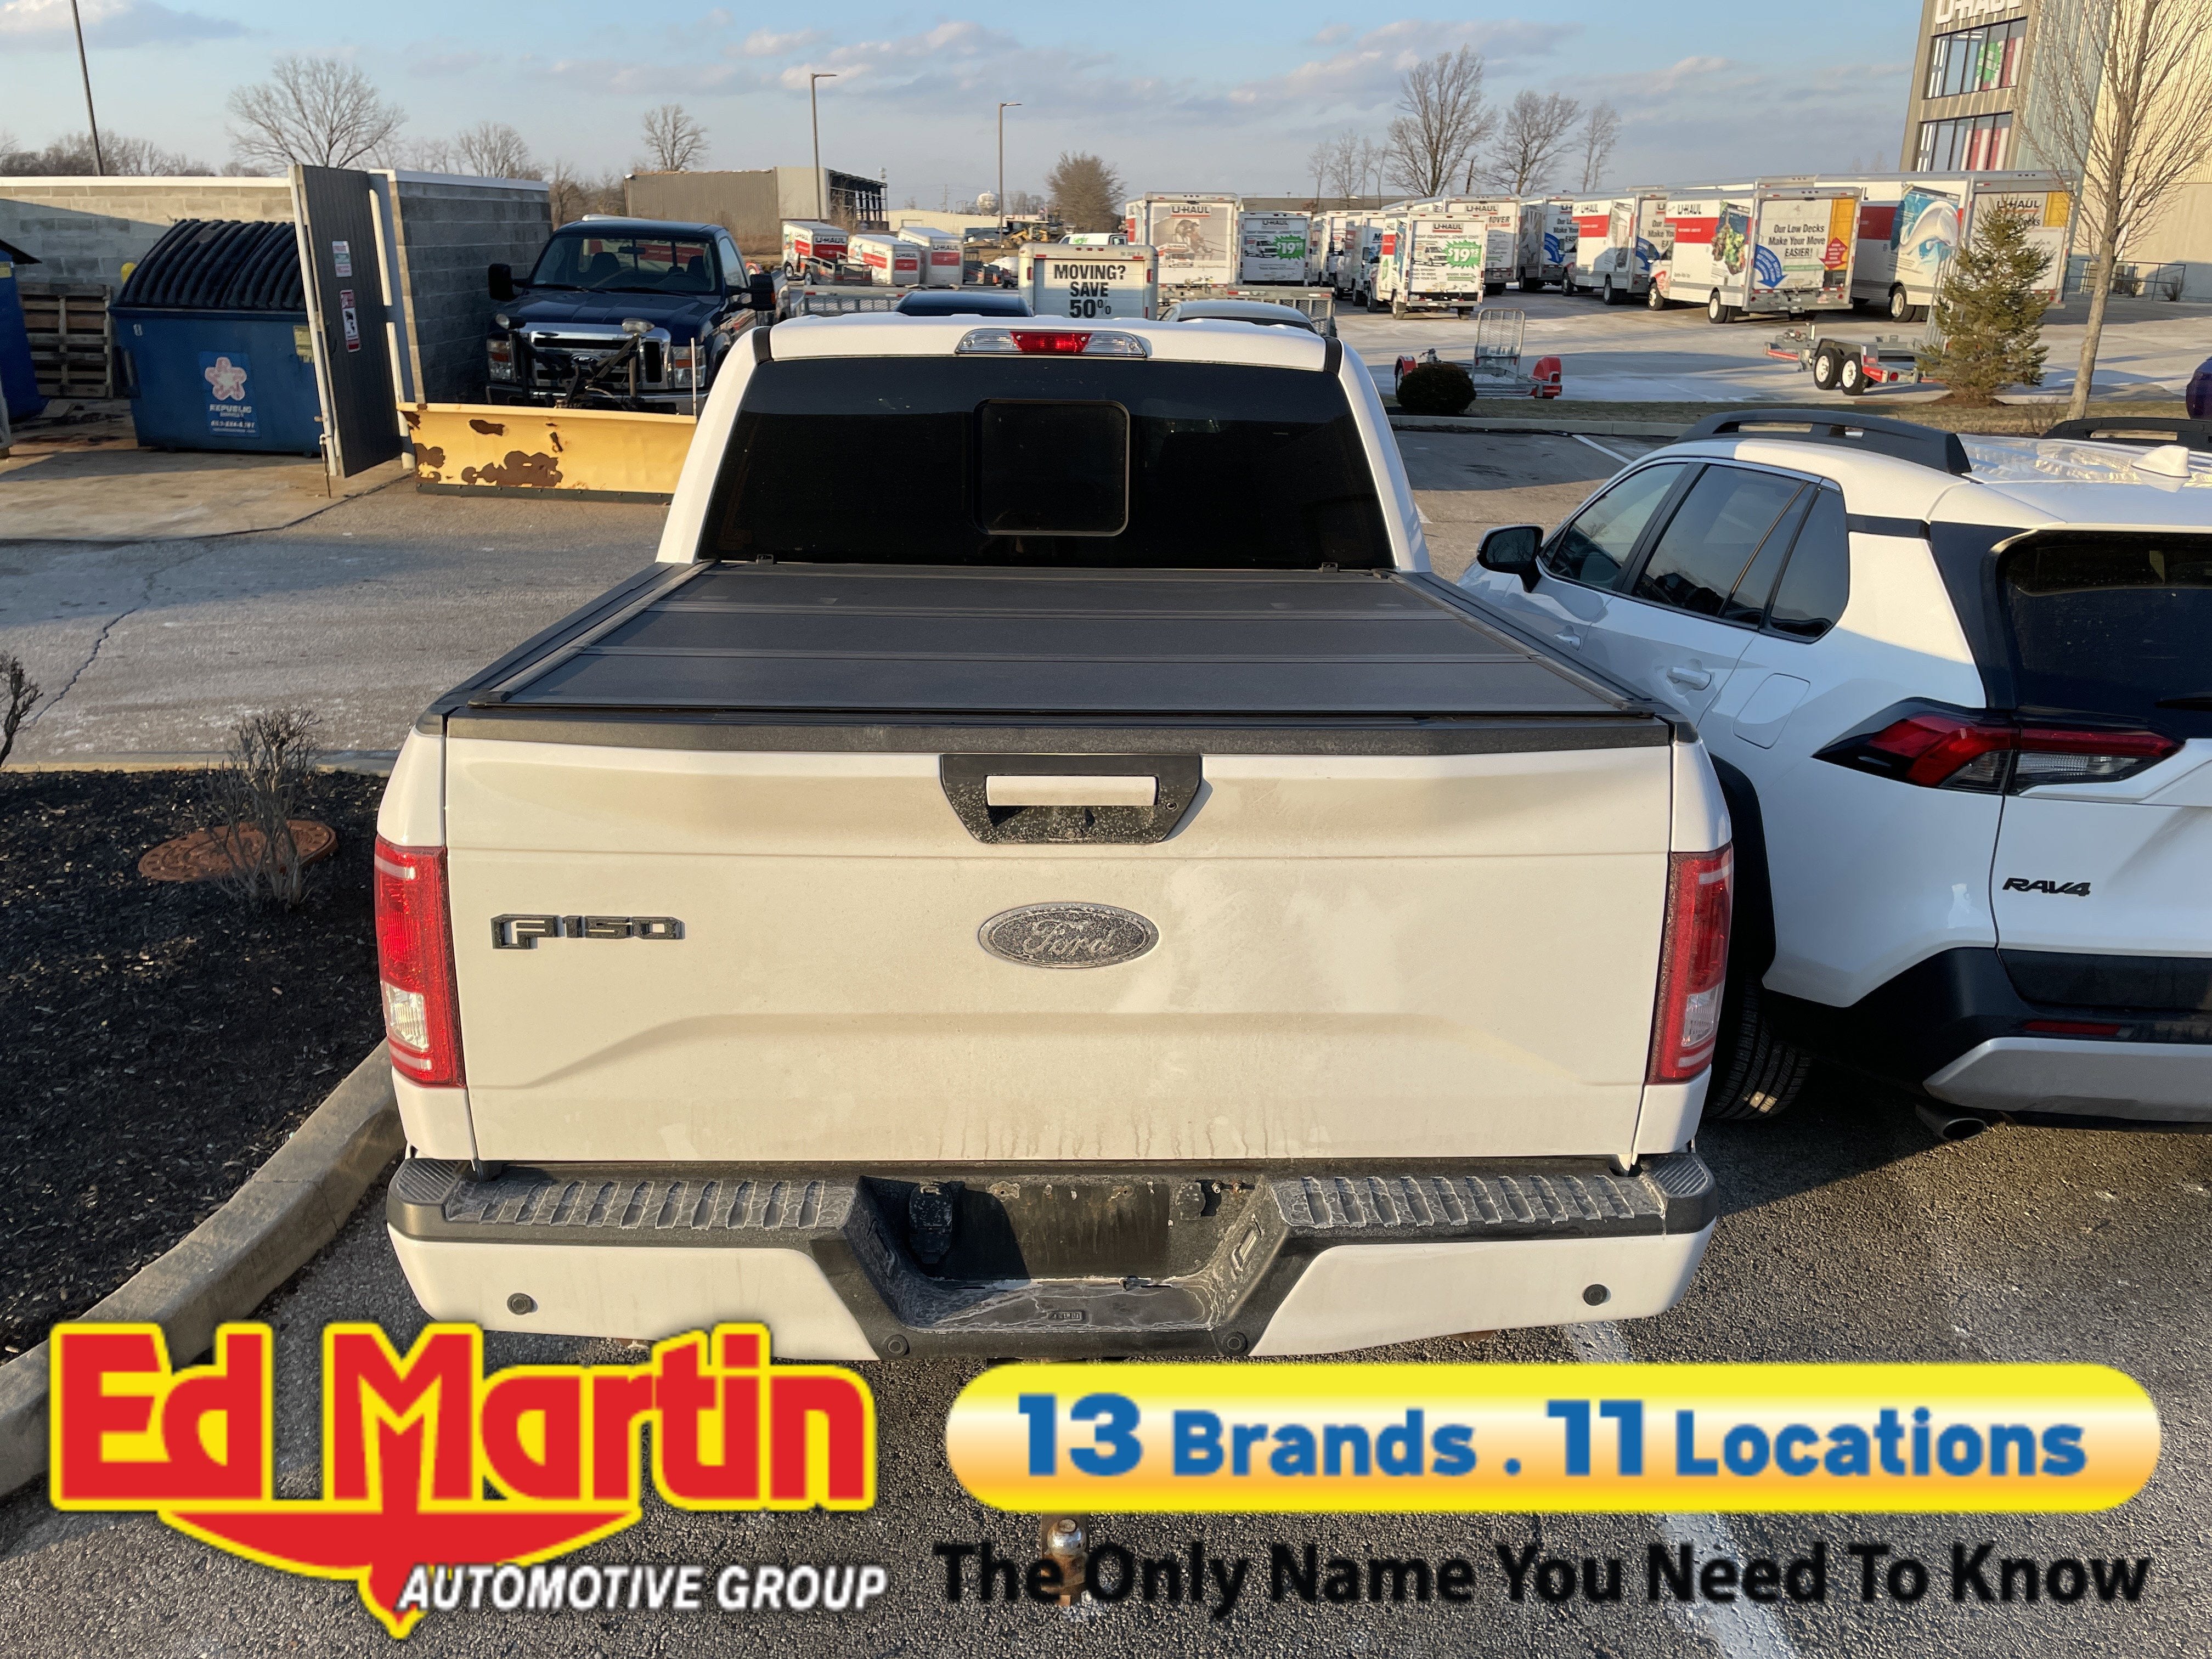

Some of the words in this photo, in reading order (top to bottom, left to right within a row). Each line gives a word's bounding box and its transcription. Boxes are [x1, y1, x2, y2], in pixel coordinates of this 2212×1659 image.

[1774, 224, 1786, 233] Our
[1787, 224, 1801, 233] Low
[1803, 224, 1825, 233] Decks
[1768, 236, 1787, 246] Make
[1790, 236, 1805, 245] Your
[1807, 236, 1826, 245] Move
[1785, 247, 1813, 257] EASIER!
[1054, 264, 1126, 280] MOVING?
[1070, 281, 1109, 297] SAVE
[1070, 298, 1111, 318] 50%
[2002, 877, 2091, 896] RAV4
[1023, 918, 1119, 956] Ford
